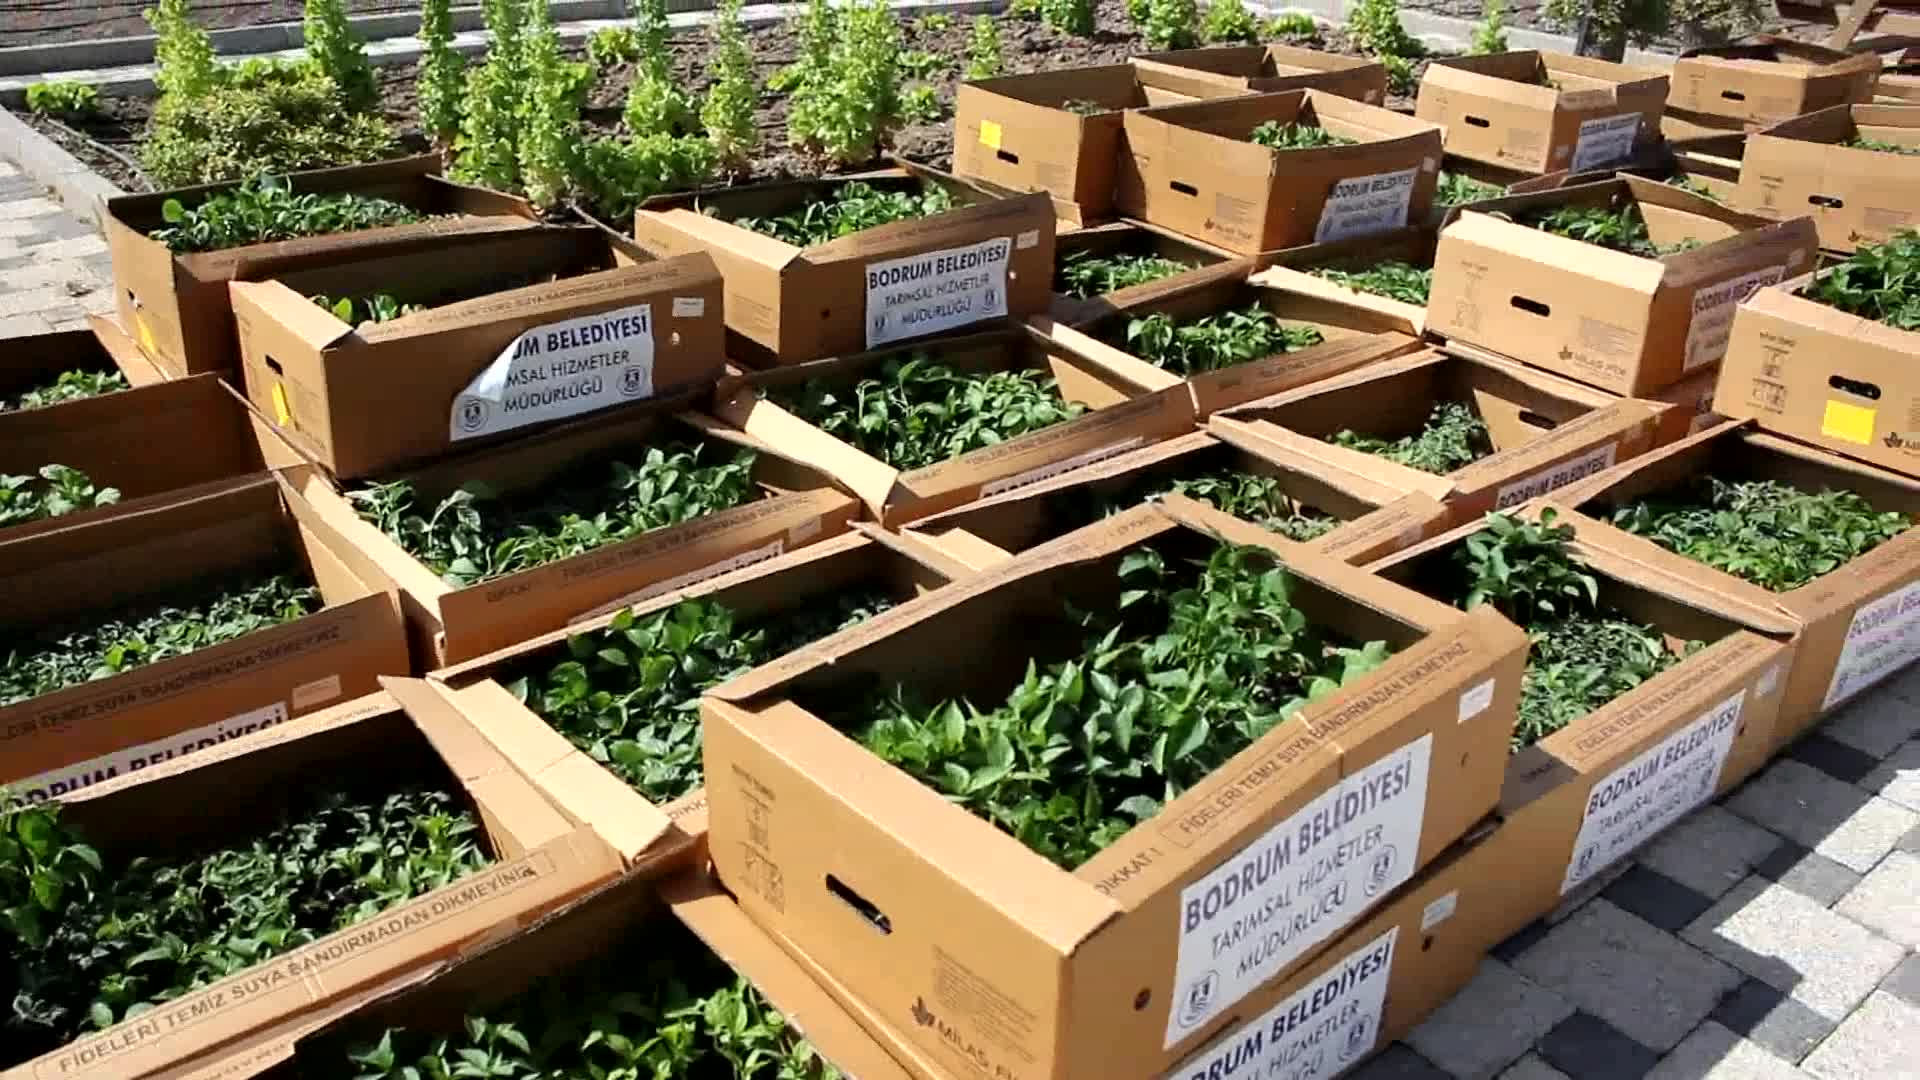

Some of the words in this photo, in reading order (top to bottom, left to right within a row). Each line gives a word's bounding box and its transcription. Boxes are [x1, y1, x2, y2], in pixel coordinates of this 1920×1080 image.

[869, 259, 932, 290] BODRUM
[547, 311, 648, 354] BELEDİYESİ
[551, 349, 631, 377] HİZMETLER
[503, 379, 603, 413] MÜDÜRLÜĞÜ
[1180, 782, 1242, 834] FİDELERİ
[1185, 836, 1291, 934] BODRUM
[1298, 752, 1411, 857] BELEDİYESİ
[1211, 886, 1293, 960] TARIMSAL
[1298, 824, 1383, 897] HİZMETLER
[1235, 879, 1348, 980] MÜDÜRLÜĞÜ
[58, 1016, 160, 1073] FİDELERİ
[165, 990, 226, 1029] TEMİZ
[231, 967, 285, 1000] SUYA
[286, 909, 431, 978] BANDIRMADAN
[1270, 942, 1390, 1046] BELEDİYESİ
[1269, 999, 1360, 1077] HİZMETLER
